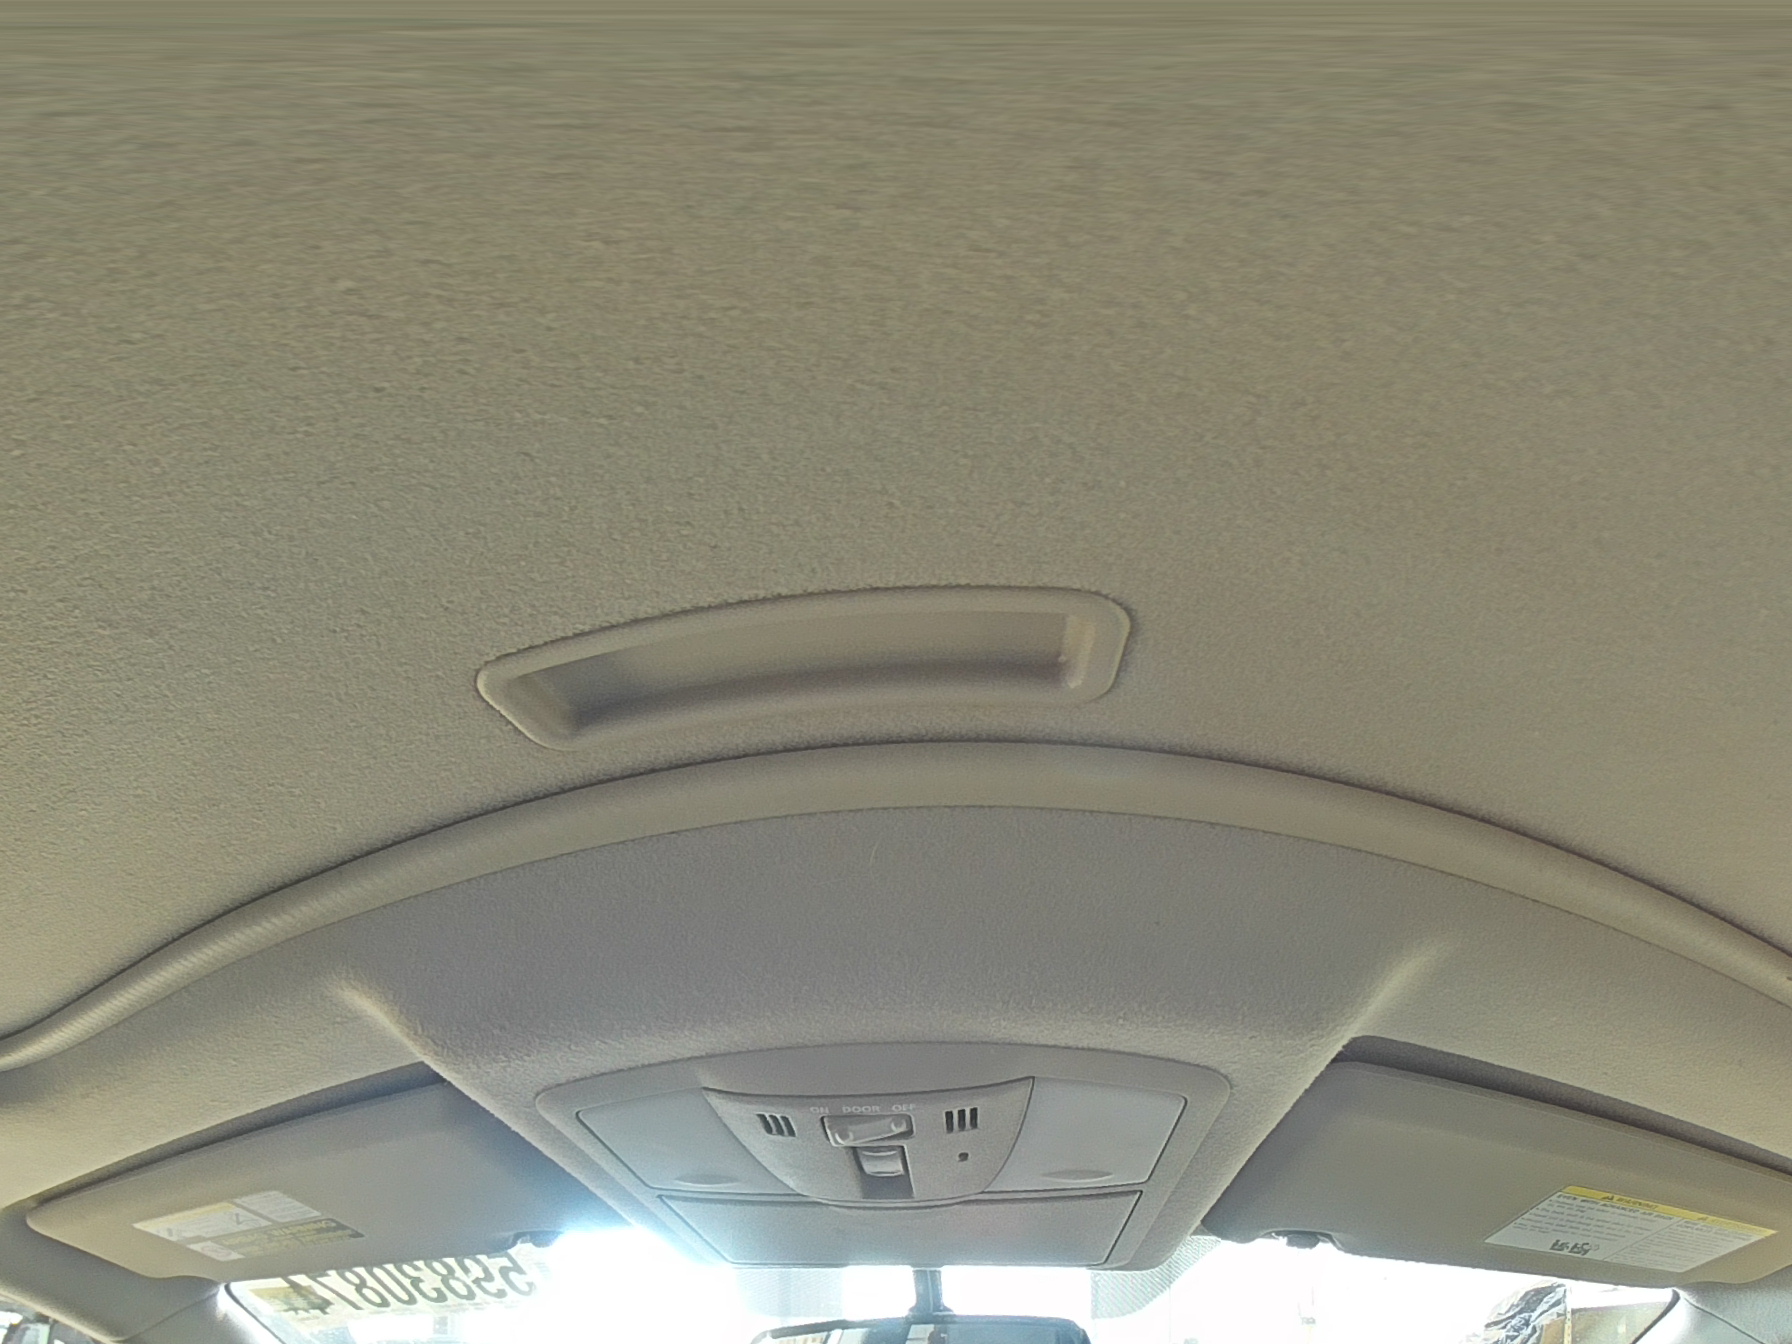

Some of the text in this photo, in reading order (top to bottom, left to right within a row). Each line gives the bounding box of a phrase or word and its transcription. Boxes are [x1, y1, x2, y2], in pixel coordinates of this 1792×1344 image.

[810, 1104, 916, 1114] ON DOOR OFF
